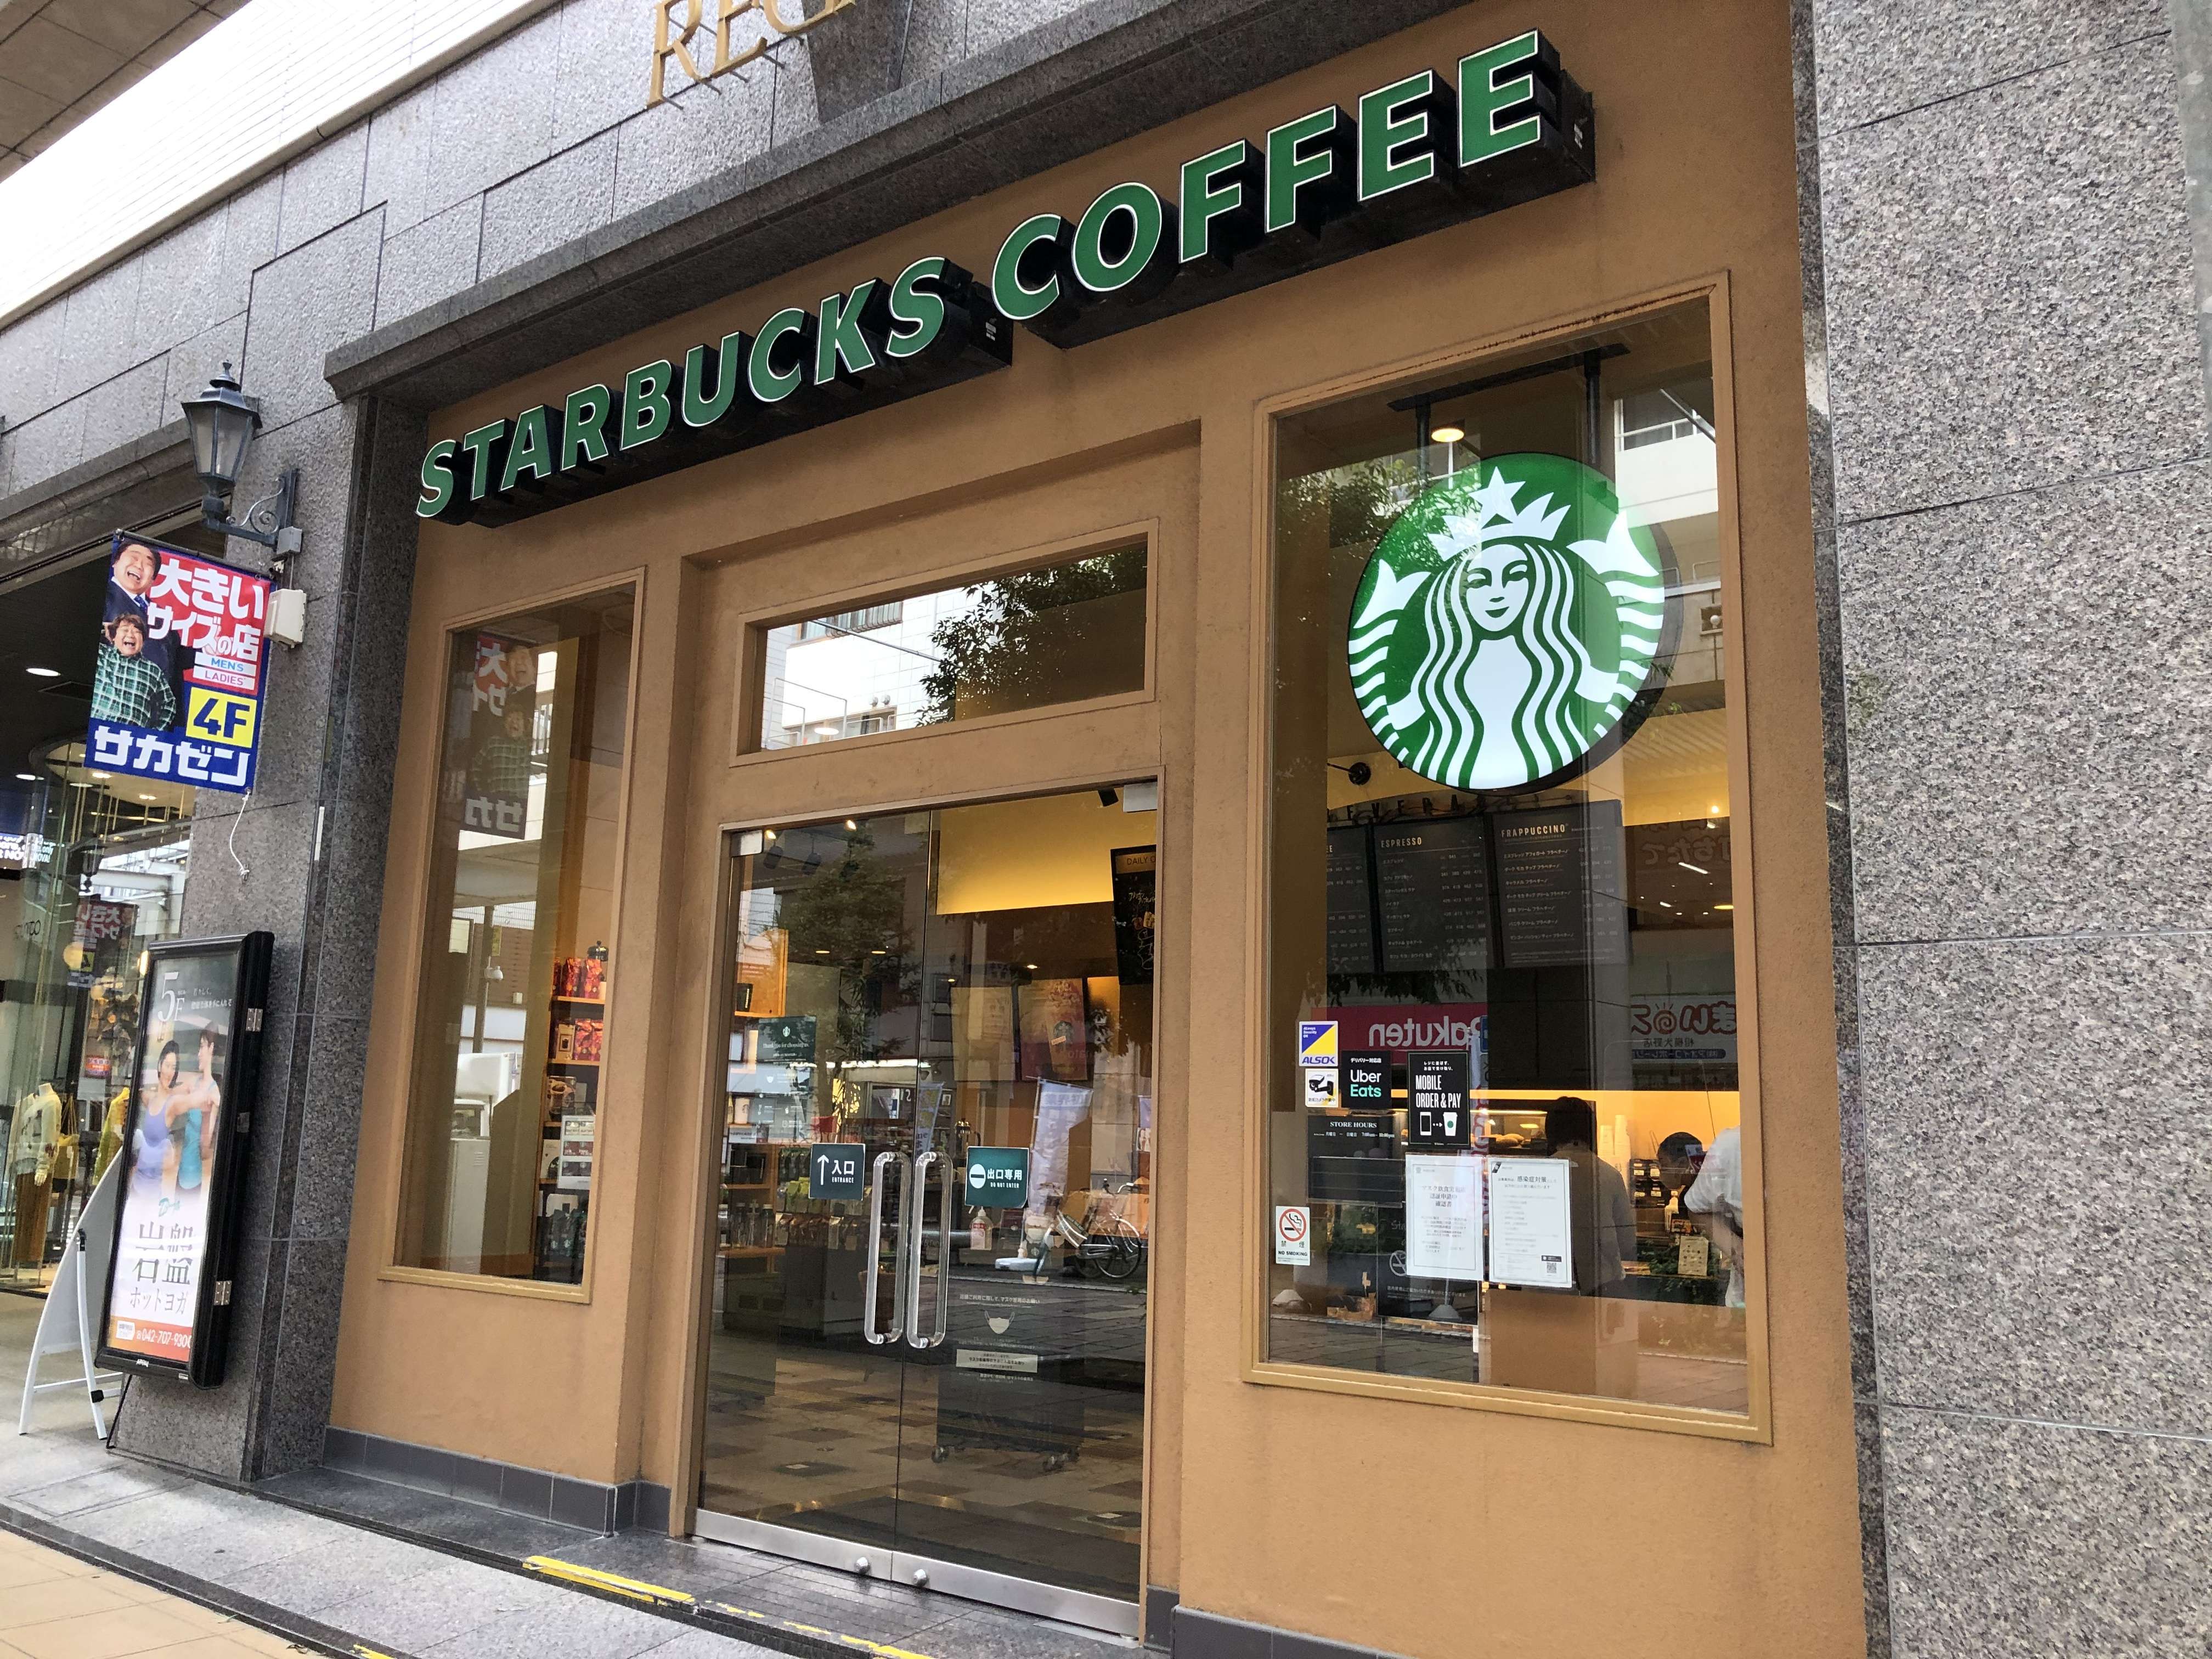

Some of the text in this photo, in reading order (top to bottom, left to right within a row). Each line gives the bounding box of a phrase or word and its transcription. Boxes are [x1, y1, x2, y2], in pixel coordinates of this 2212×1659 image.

[415, 29, 1541, 518] STARBUCKS COFFEE
[151, 558, 264, 620] 大きい
[147, 602, 261, 662] サイズの店
[193, 697, 250, 739] 4F
[94, 726, 250, 787] サカゼン
[1501, 824, 1566, 838] FRAPPUCCINO
[1380, 837, 1423, 848] ESPRESSO
[1127, 856, 1148, 865] DAILY
[1350, 1069, 1382, 1083] Uber
[1415, 1075, 1442, 1091] MOBILE
[1350, 1084, 1382, 1097] Eats
[1415, 1092, 1462, 1109] ORDER & PAY
[831, 1159, 855, 1176] 入口
[987, 1169, 1023, 1181] 出口専用
[129, 1286, 188, 1315] ホットヨガ
